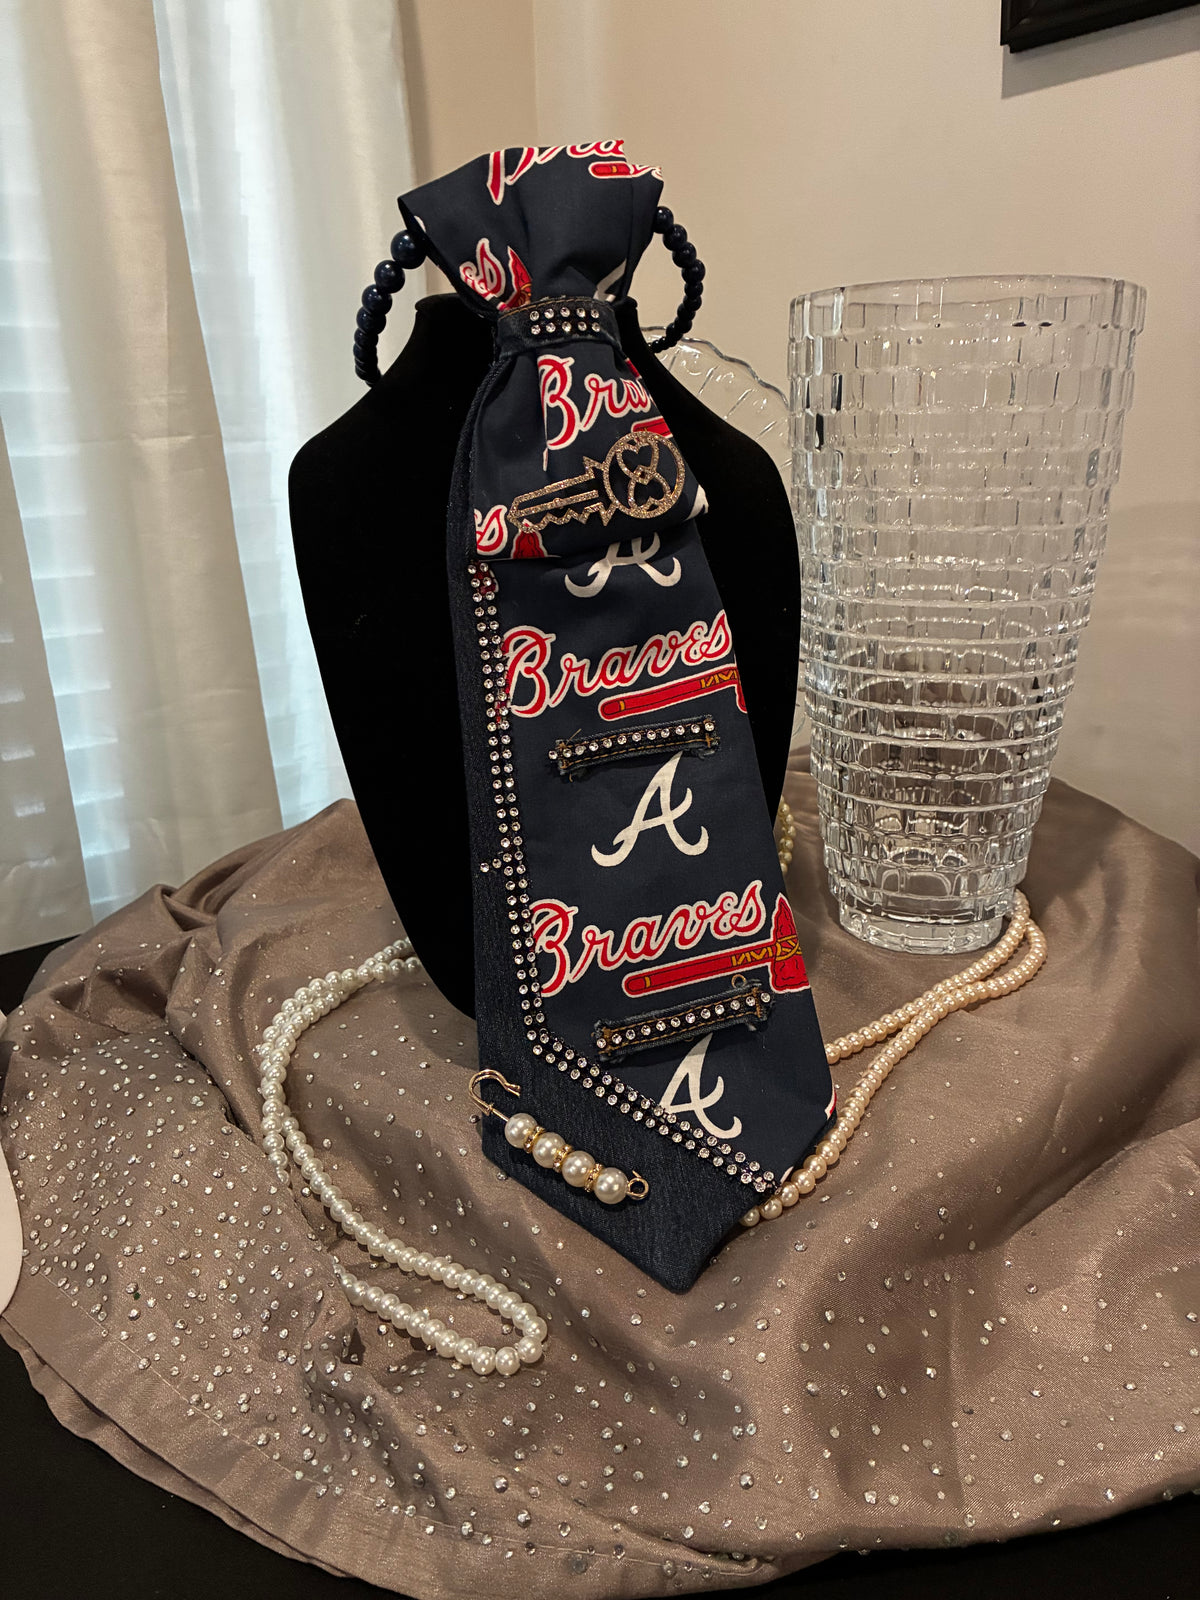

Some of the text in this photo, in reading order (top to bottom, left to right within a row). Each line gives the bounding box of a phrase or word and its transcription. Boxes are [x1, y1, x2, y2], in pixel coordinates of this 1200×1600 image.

[537, 354, 656, 450] Bra
[501, 609, 732, 718] Braves
[591, 751, 709, 867] A
[529, 880, 763, 997] Braves
[658, 1033, 742, 1139] A
